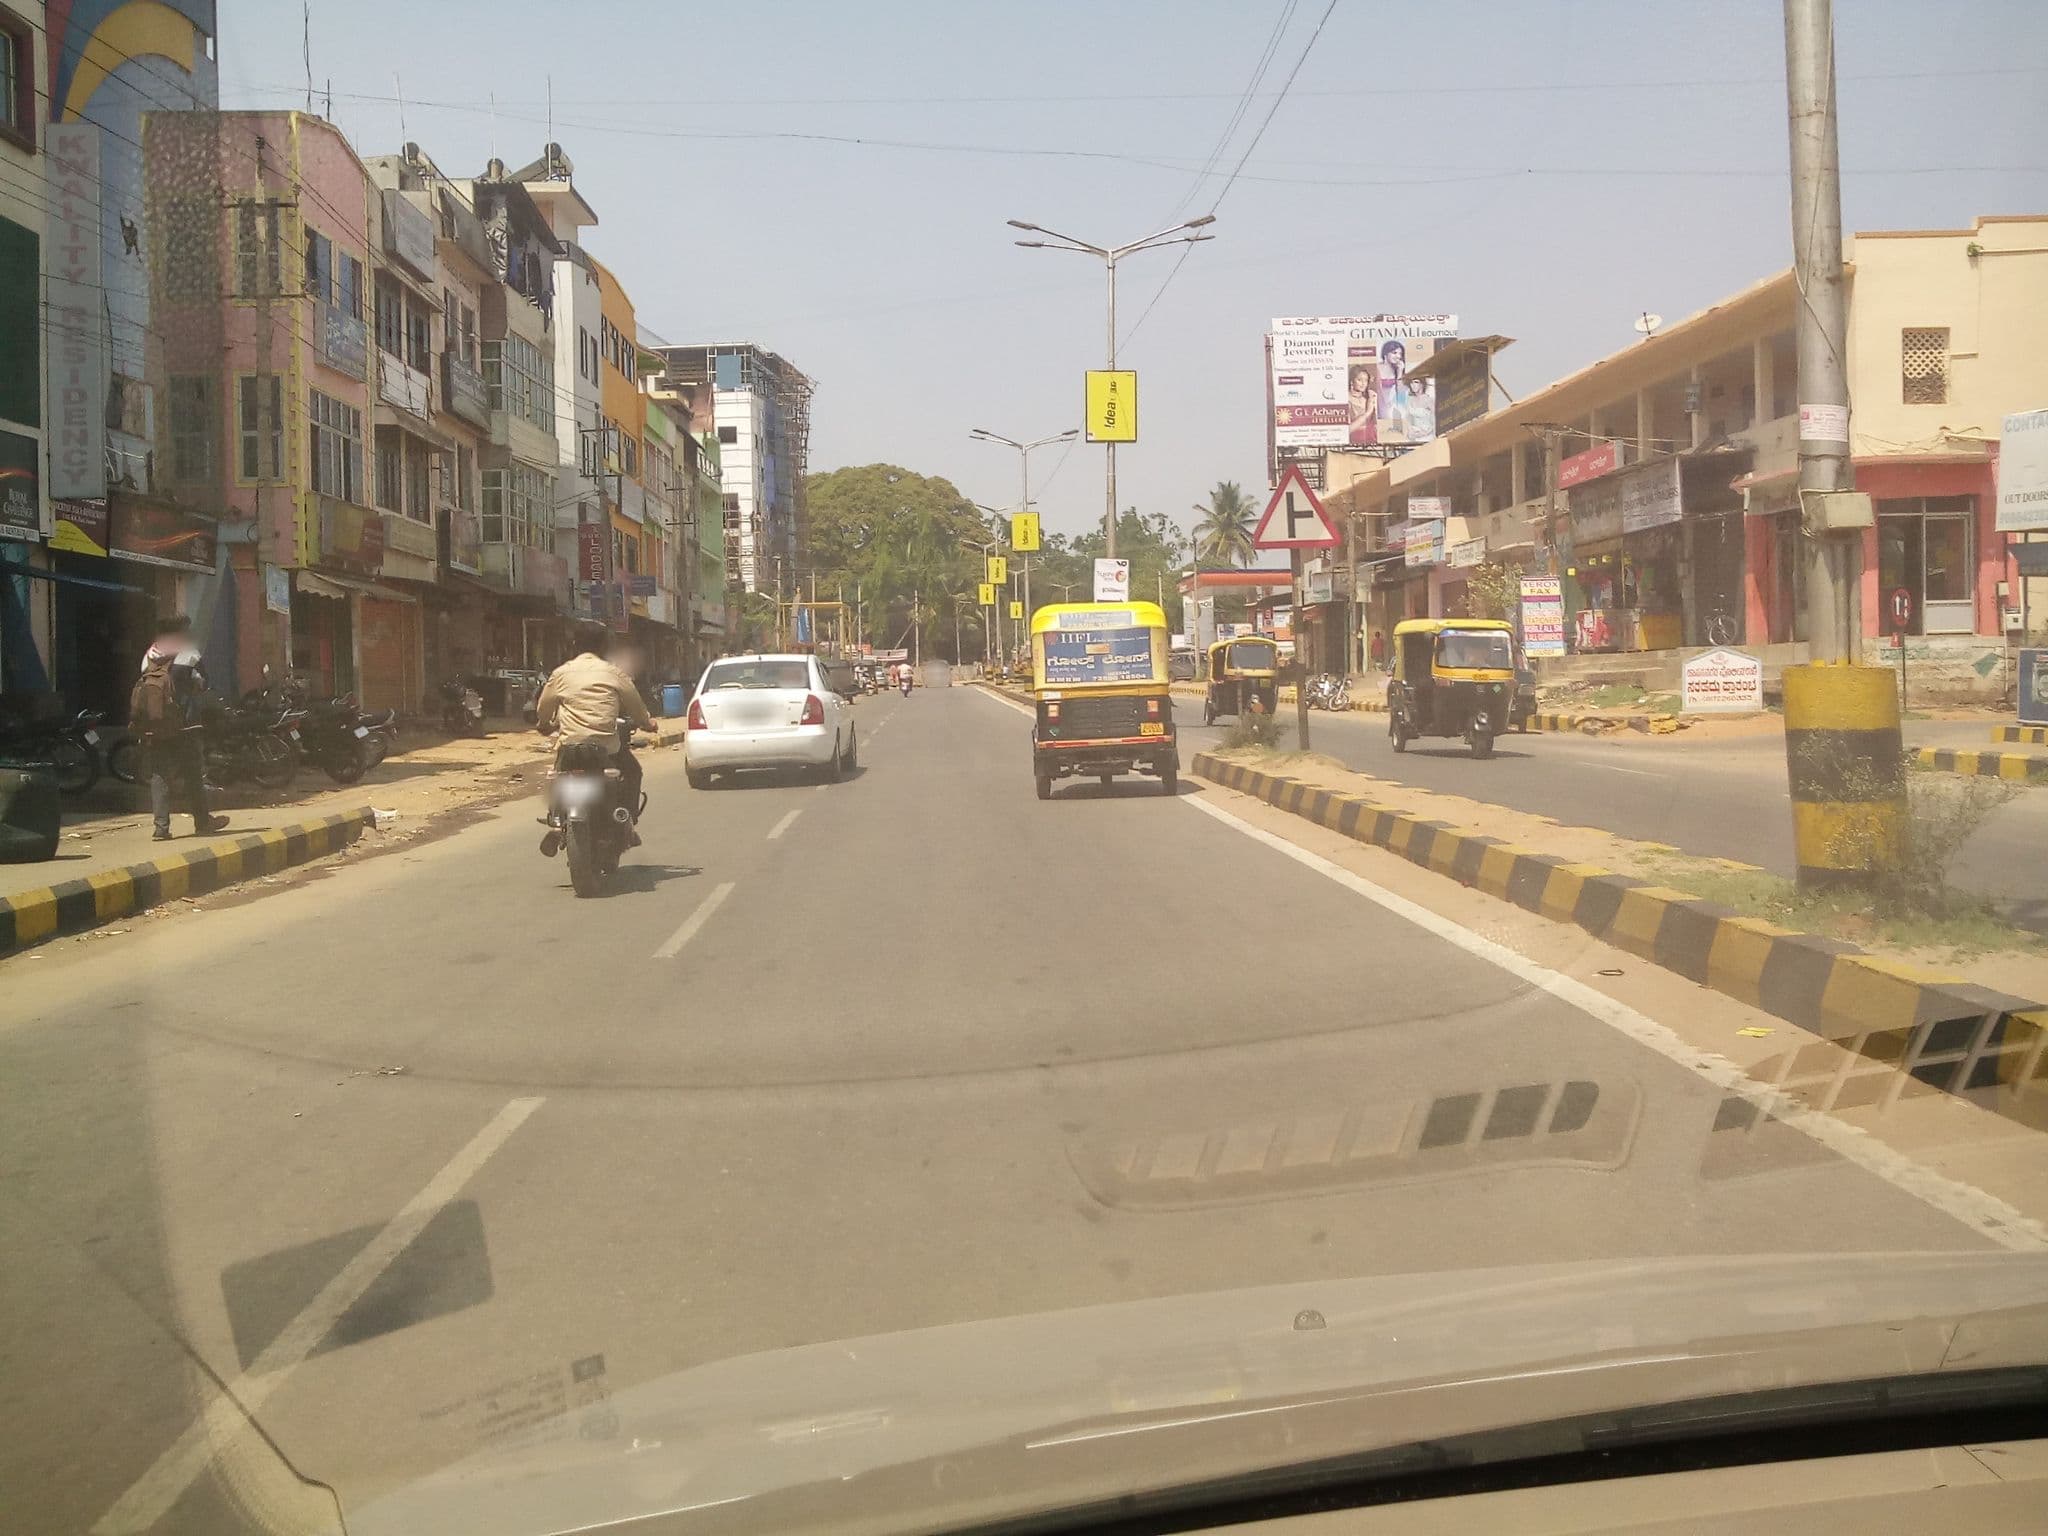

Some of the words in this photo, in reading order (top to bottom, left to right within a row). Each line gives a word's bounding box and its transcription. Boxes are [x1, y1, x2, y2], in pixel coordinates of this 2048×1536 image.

[1350, 327, 1420, 340] GITANJALI
[1284, 338, 1334, 348] Diamond
[1283, 348, 1335, 357] Jewellery
[1311, 407, 1346, 416] Acharya
[1061, 632, 1097, 644] IIFL
